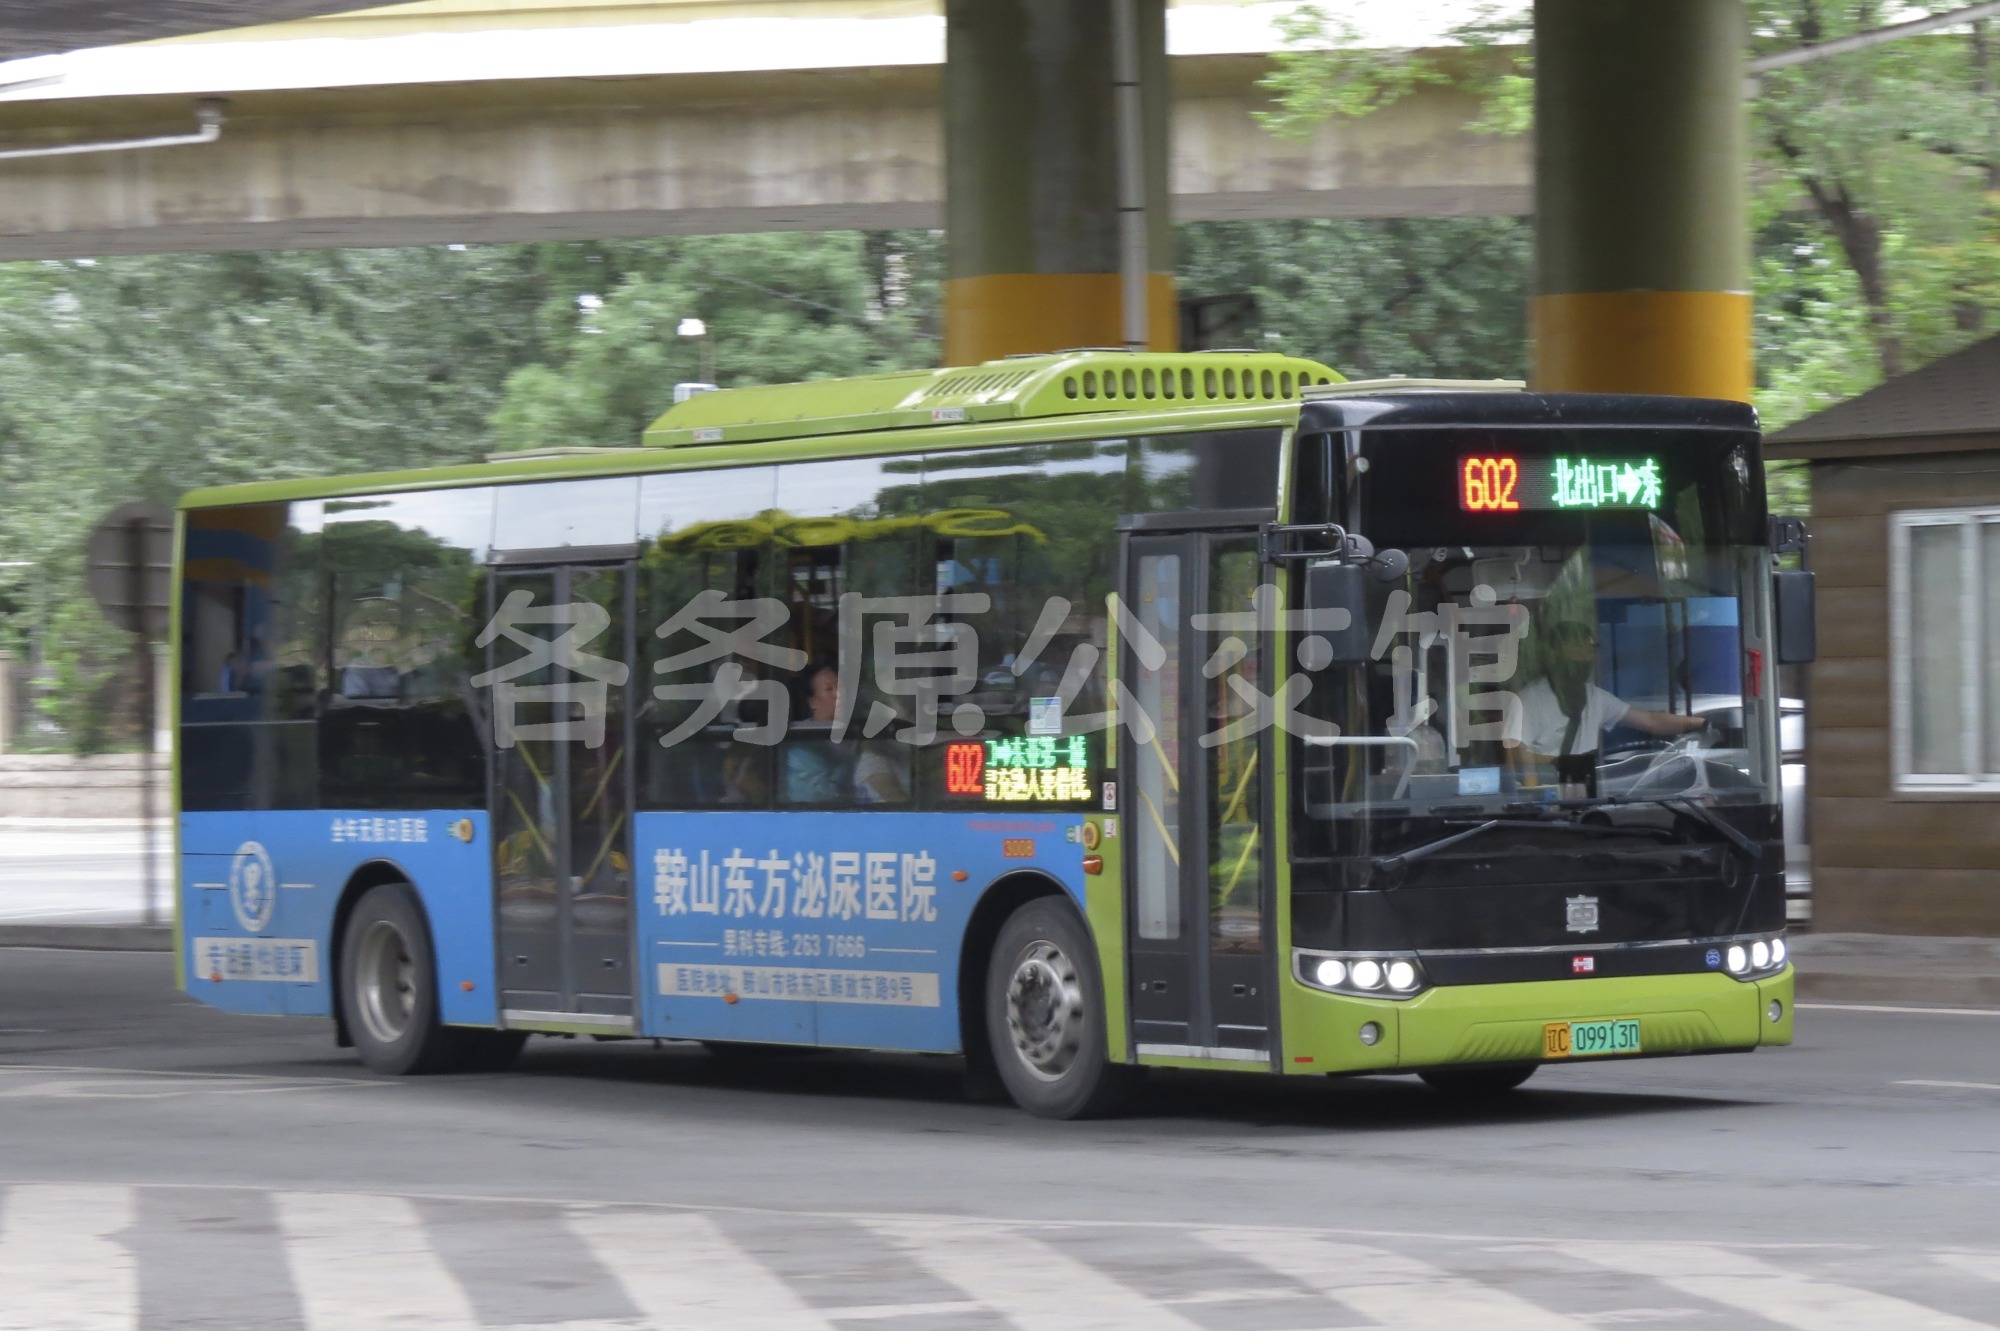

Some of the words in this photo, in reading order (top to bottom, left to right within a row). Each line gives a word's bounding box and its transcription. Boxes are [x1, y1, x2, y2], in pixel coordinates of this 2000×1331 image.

[1465, 458, 1519, 509] 602
[947, 743, 984, 793] 602
[654, 847, 938, 923] 鞍山东方泌尿医院
[825, 935, 866, 958] 7666
